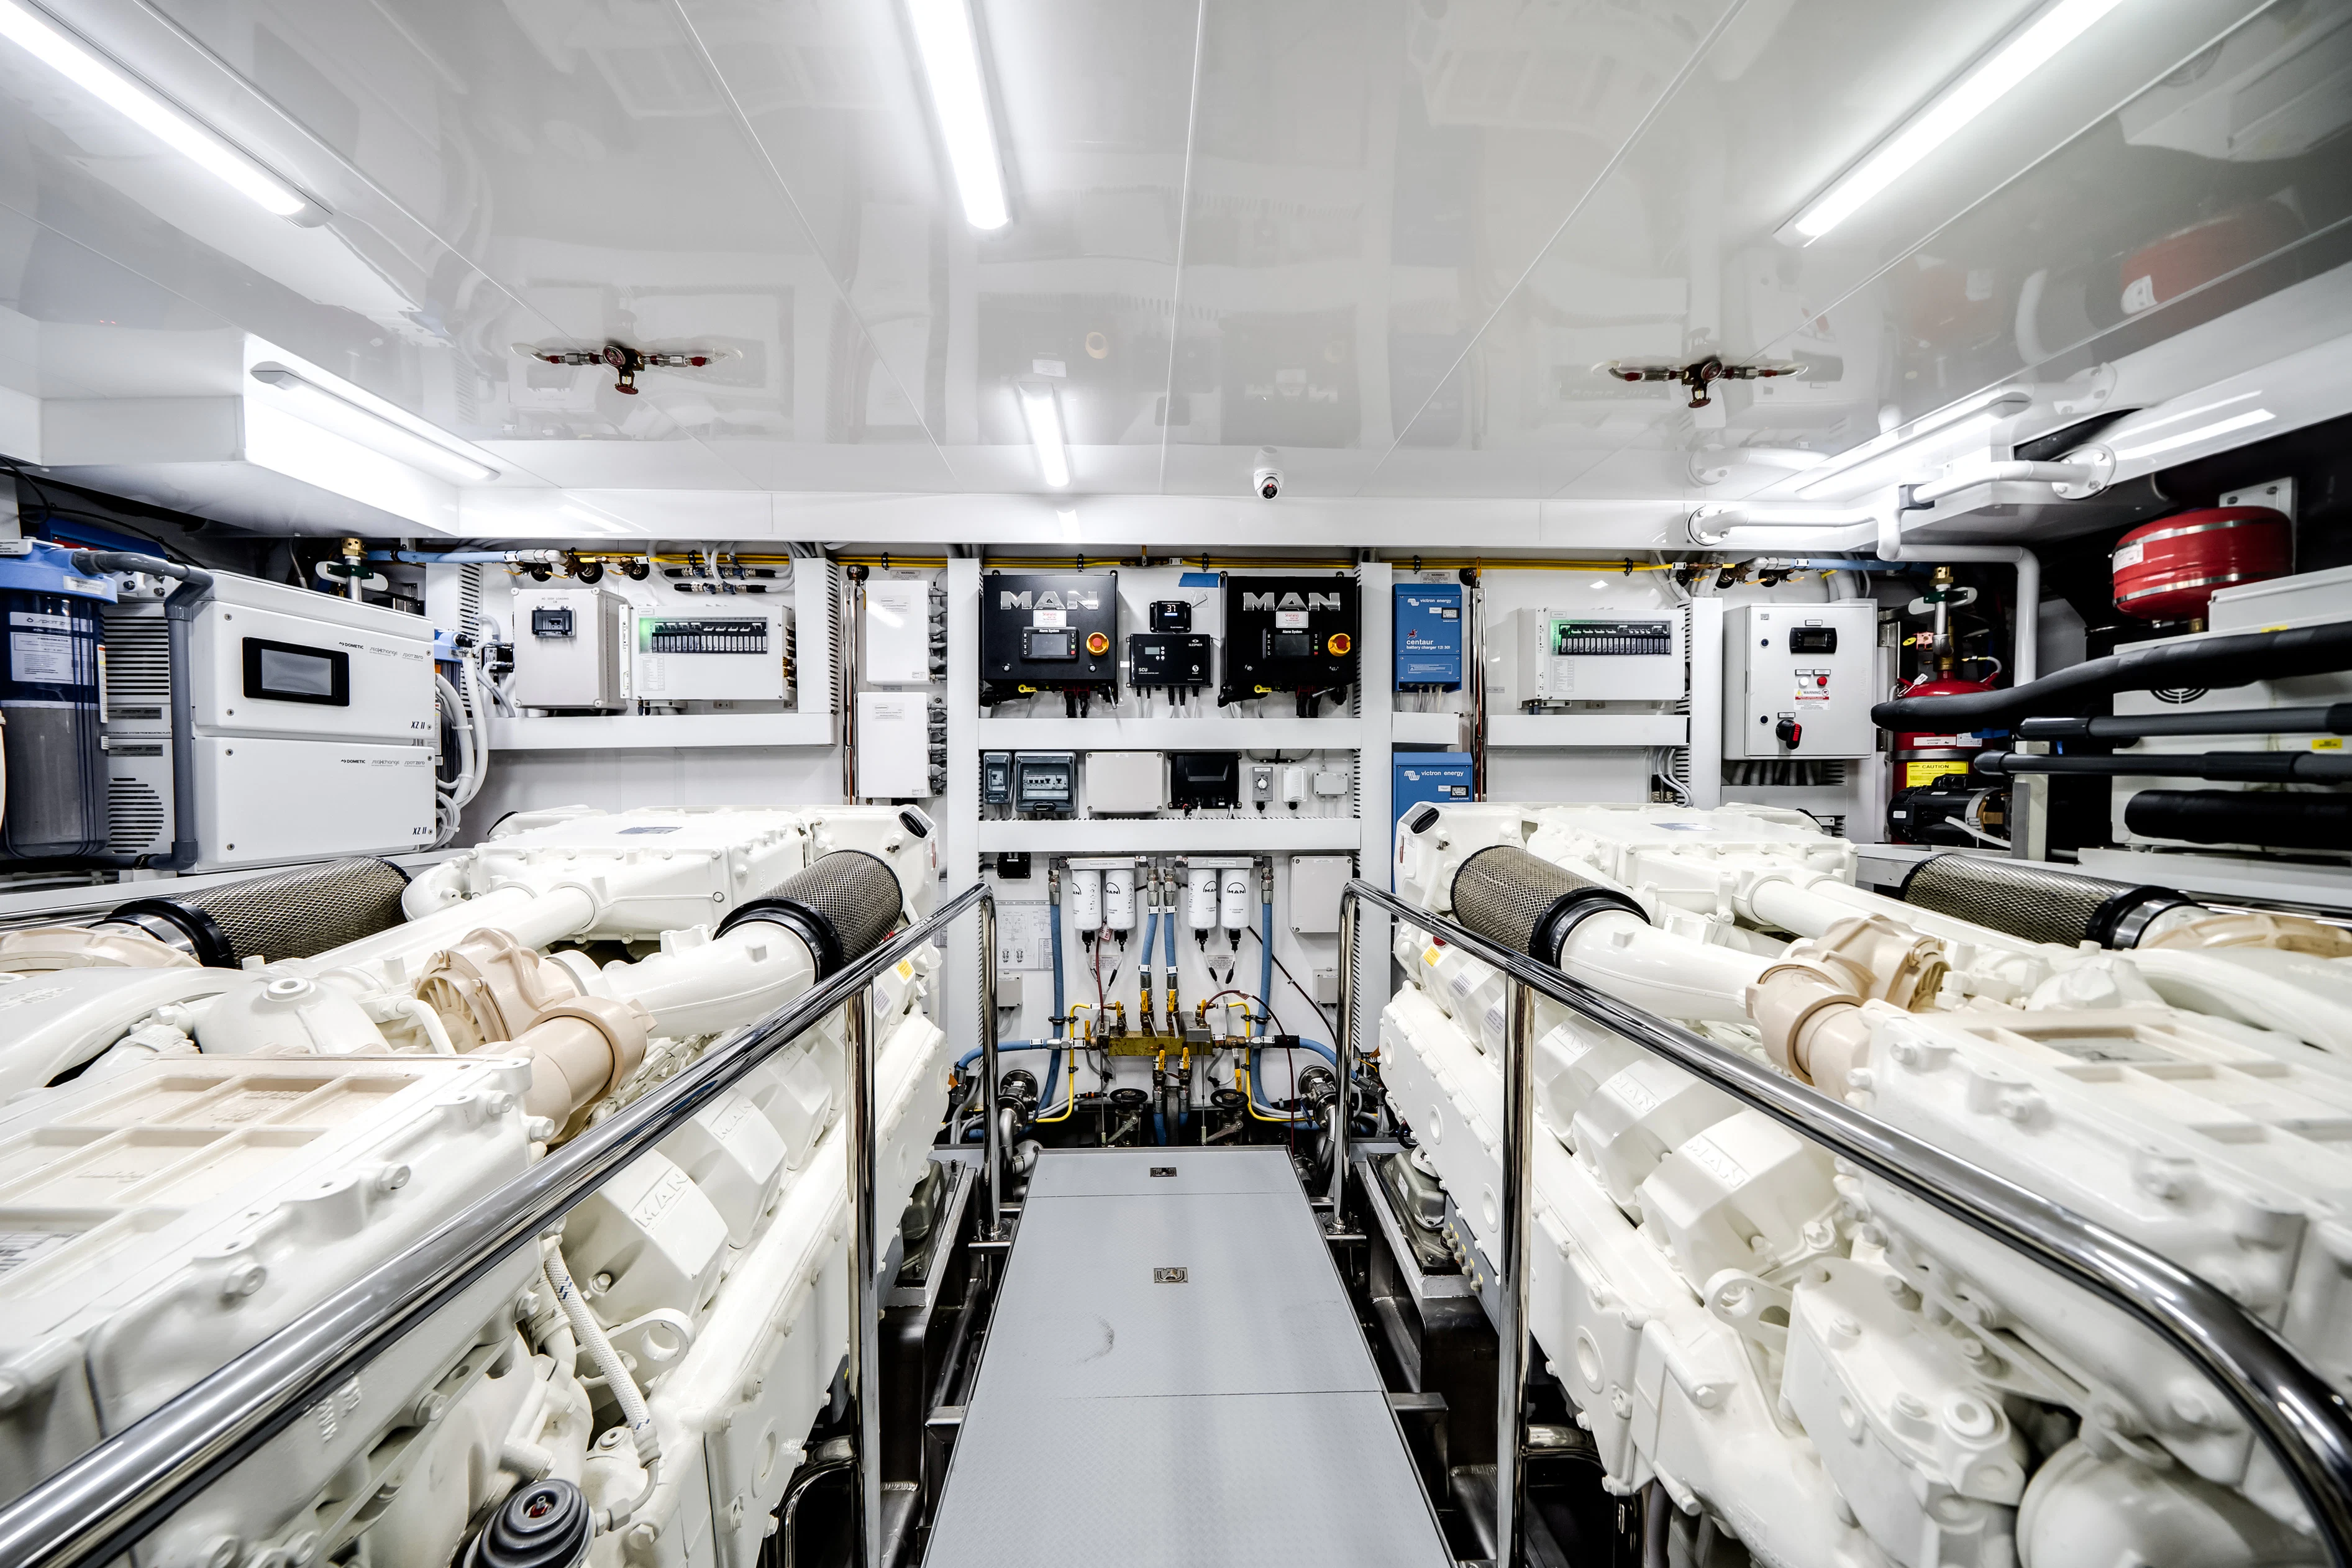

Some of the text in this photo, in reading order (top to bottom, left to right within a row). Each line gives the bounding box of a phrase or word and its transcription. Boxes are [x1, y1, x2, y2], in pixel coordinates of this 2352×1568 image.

[1001, 591, 1099, 610] MAN
[1167, 604, 1176, 613] 37
[1243, 592, 1341, 611] MAN
[411, 721, 419, 729] XZ
[413, 827, 421, 835] XZ
[1613, 1072, 1656, 1112] MAN
[713, 1097, 754, 1141] MAN
[1685, 1137, 1746, 1188] MAN
[634, 1170, 689, 1228] MAN
